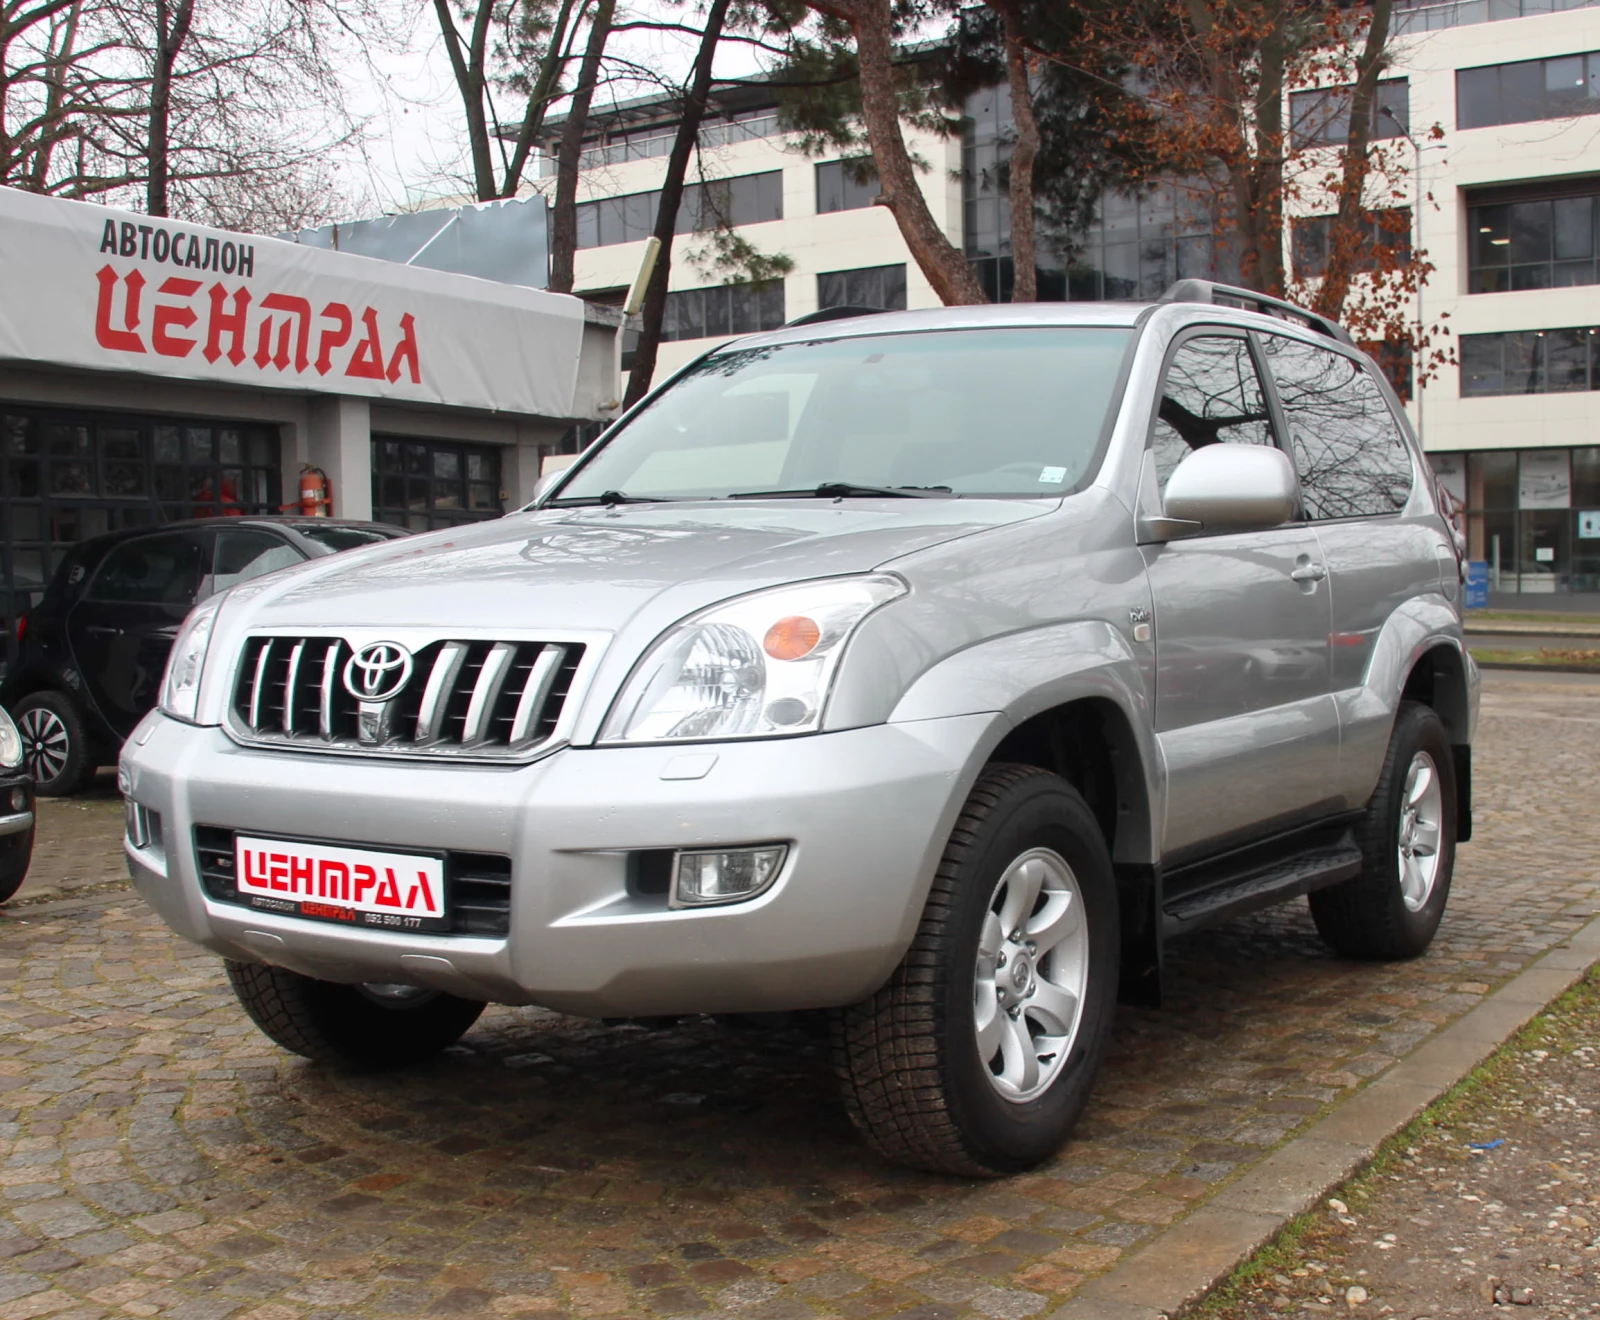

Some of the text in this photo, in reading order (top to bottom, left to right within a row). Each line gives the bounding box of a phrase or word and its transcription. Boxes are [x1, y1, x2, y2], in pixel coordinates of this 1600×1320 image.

[101, 219, 254, 277] АВТОСАЛОН
[95, 264, 421, 384] ЦЕНТРАЛ
[244, 849, 436, 912] ЦЕНТРАЛ
[403, 917, 422, 928] 177
